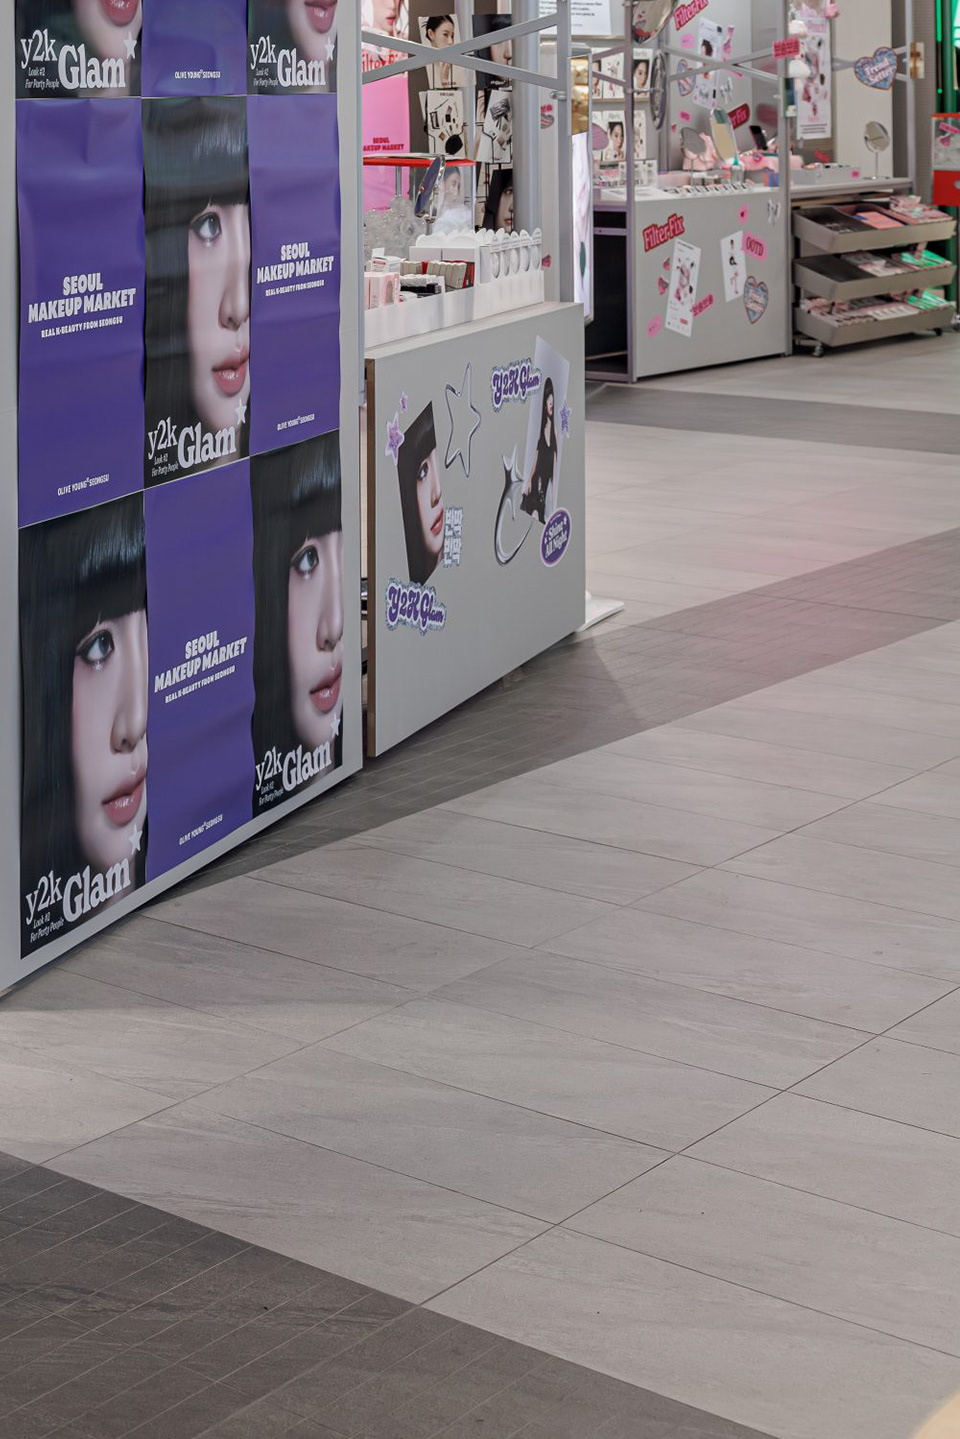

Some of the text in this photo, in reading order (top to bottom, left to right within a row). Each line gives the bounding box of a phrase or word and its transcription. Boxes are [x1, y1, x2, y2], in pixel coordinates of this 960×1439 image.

[20, 28, 126, 90] y2k Glam
[250, 35, 326, 87] y2k Glam
[644, 215, 684, 250] Filter Fix
[281, 242, 310, 261] SEOUL
[63, 272, 103, 296] SEOUL
[257, 255, 334, 284] MAKEUP MARKET
[28, 288, 136, 323] MAKEUP MARKET
[41, 316, 123, 338] REAL K-BEAUTY FROM SEONGSU
[148, 416, 236, 468] y2k Glam
[185, 631, 220, 659] SEOUL
[154, 636, 247, 693] MAKEUP MARKET
[165, 692, 177, 704] REAL
[255, 741, 332, 791] y2k Glam
[25, 858, 131, 925] y2k Glam
